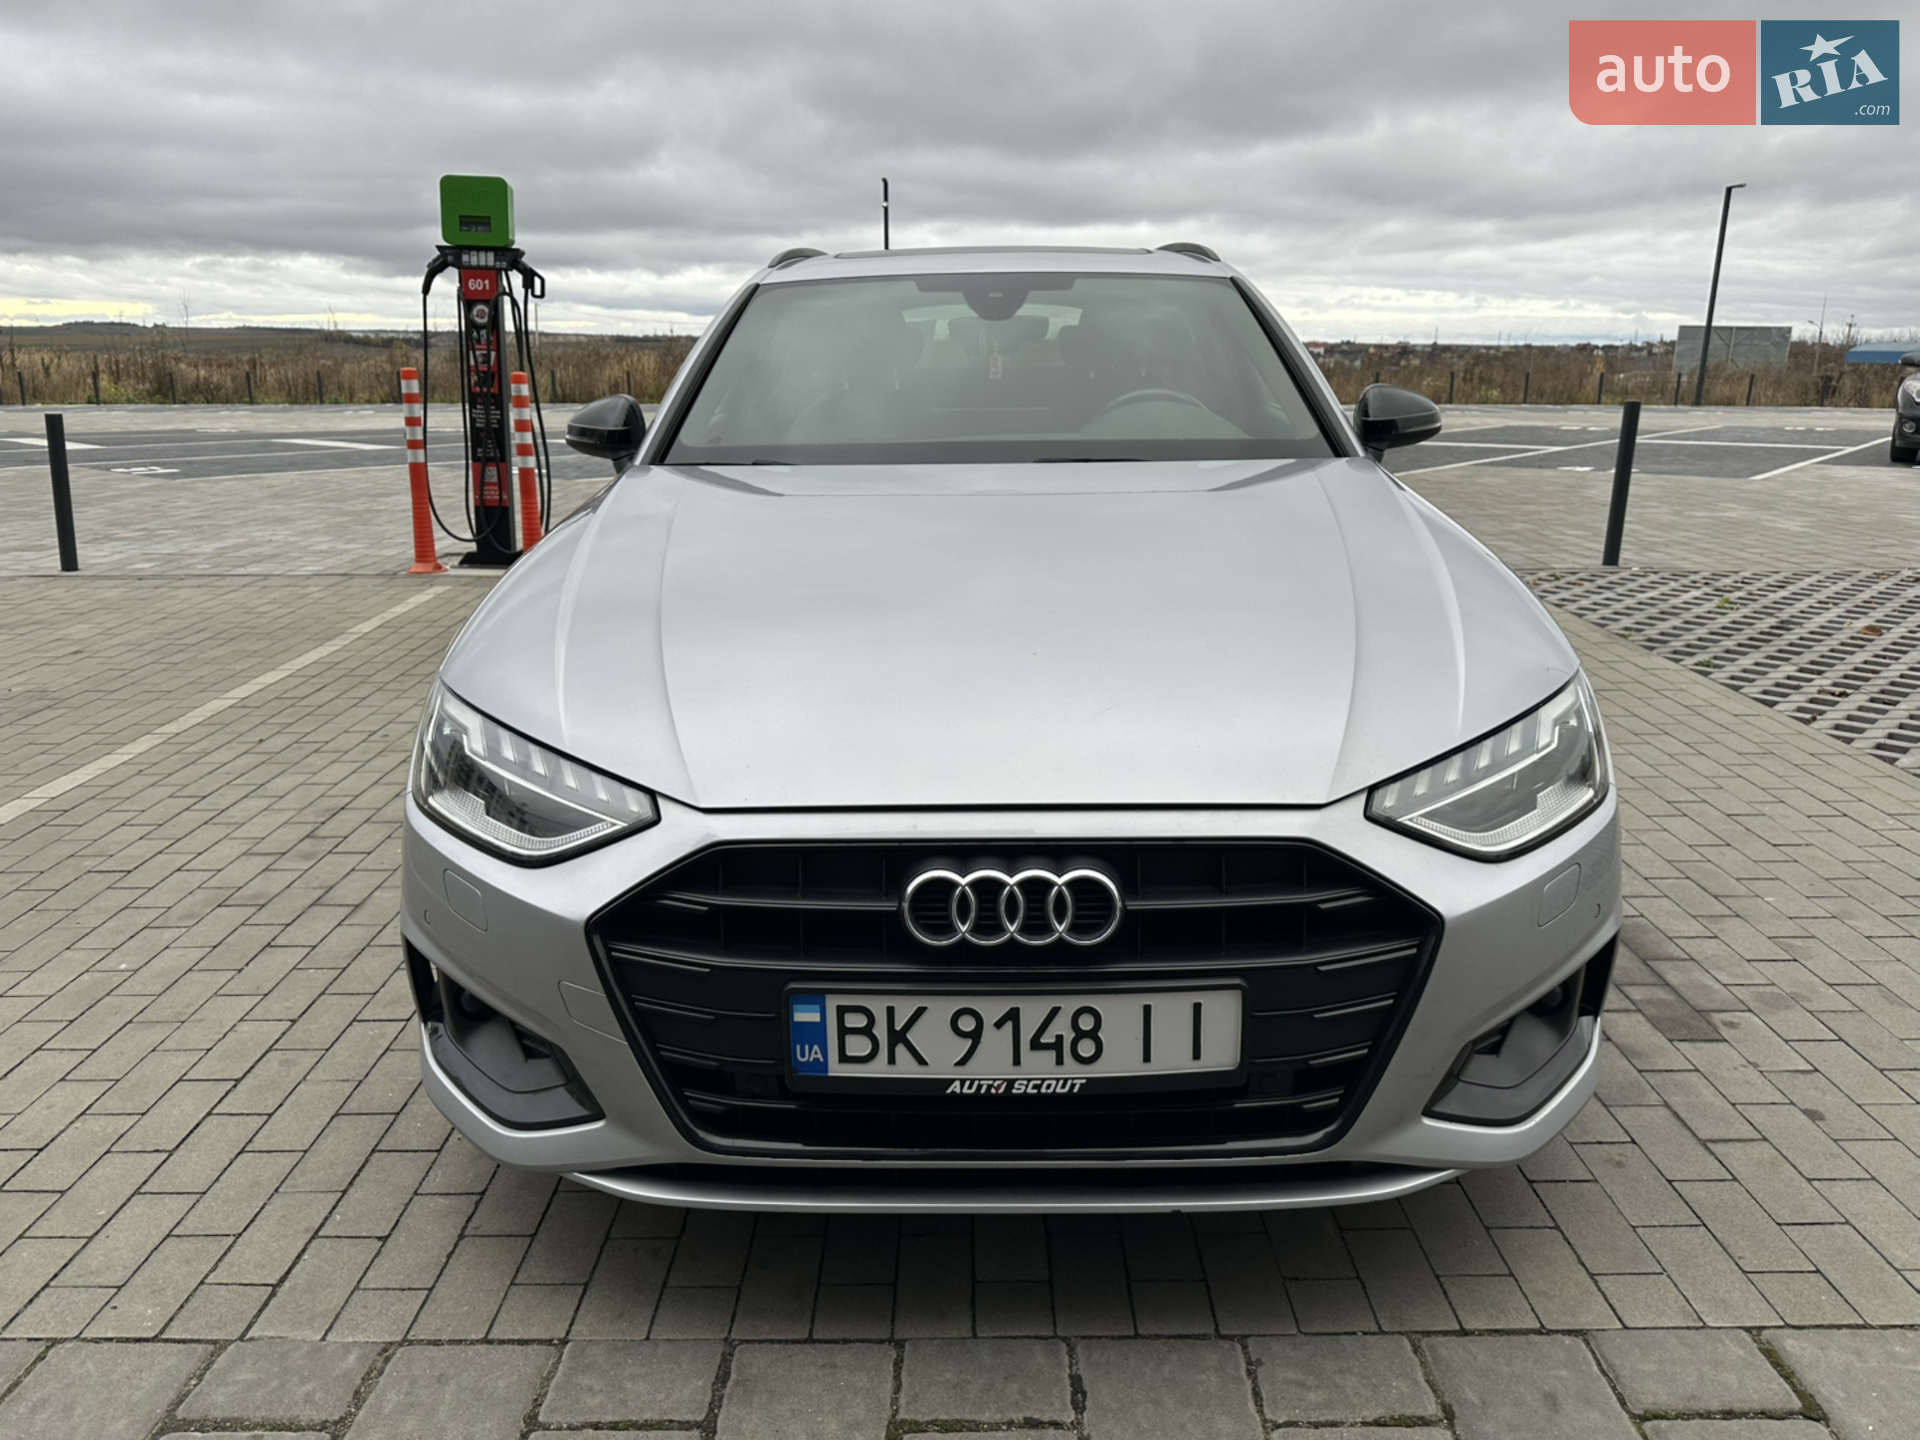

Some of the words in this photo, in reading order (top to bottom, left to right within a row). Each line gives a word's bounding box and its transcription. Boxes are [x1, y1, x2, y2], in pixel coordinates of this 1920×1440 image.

[468, 278, 490, 291] 601
[836, 1005, 929, 1066] BK
[950, 1006, 1103, 1066] 9148
[796, 1044, 823, 1063] UA
[945, 1079, 1007, 1094] AUTO
[1011, 1079, 1087, 1094] SCOUT
